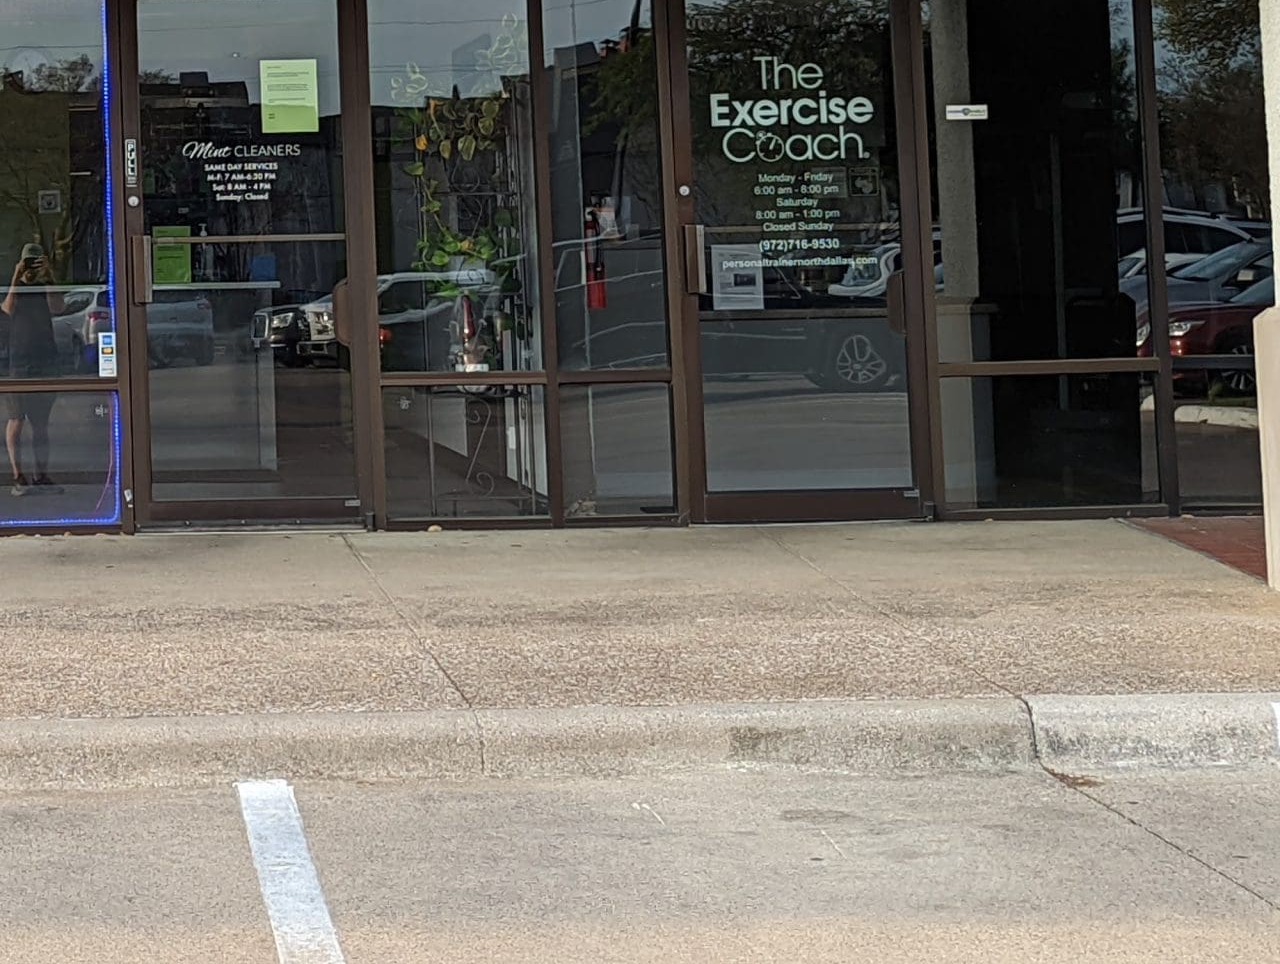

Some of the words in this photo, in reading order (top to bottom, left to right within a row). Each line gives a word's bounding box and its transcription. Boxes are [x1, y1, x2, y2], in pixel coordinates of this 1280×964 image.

[753, 56, 824, 90] The
[709, 90, 874, 127] Exercise
[182, 141, 233, 159] Mint
[234, 144, 301, 157] CLEANERS
[127, 143, 136, 176] PULL
[204, 163, 226, 172] SAME
[227, 163, 242, 172] DAY
[244, 162, 278, 172] SERVICES
[758, 174, 796, 185] Monday
[245, 192, 269, 200] Closed
[824, 186, 839, 196] pm
[776, 198, 819, 208] Saturday
[803, 209, 823, 218] 1:00
[825, 210, 840, 220] pm
[763, 223, 796, 232] Closed
[798, 221, 835, 233] Sunday
